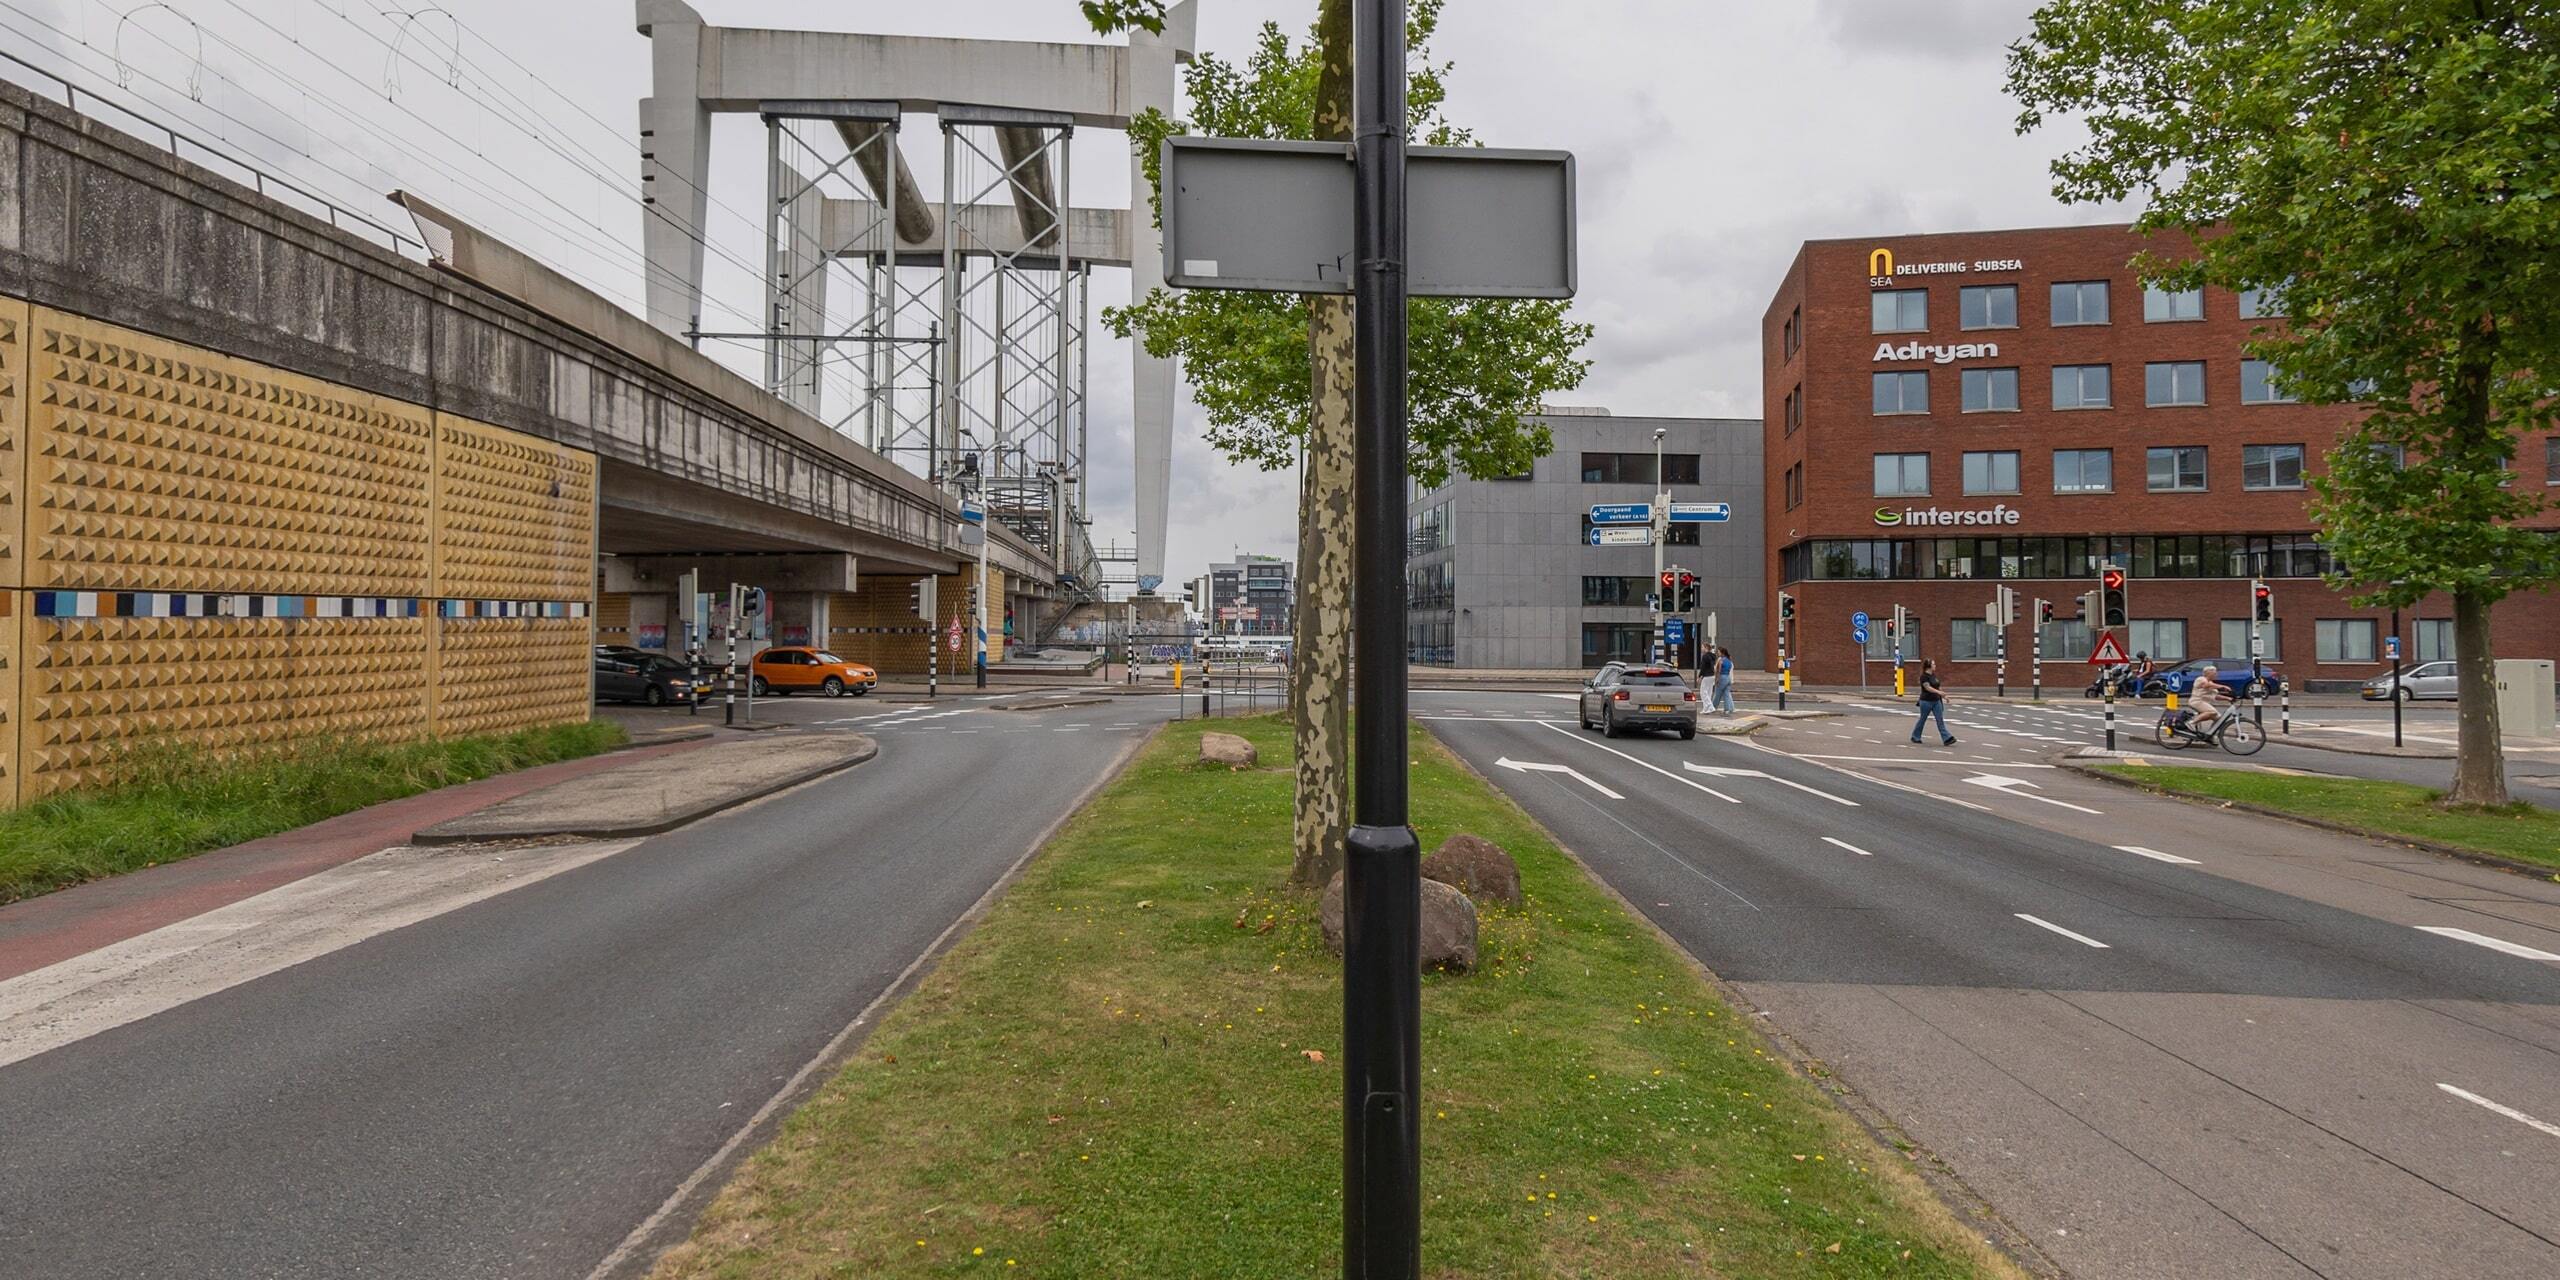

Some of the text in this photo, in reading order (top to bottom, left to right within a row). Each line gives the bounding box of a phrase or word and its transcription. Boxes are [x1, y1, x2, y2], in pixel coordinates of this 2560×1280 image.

[1896, 259, 2023, 276] DELIVERING SUBSEA
[1870, 277, 1893, 287] SEA
[1872, 341, 1998, 364] Adryan
[1905, 504, 2020, 526] intersafe
